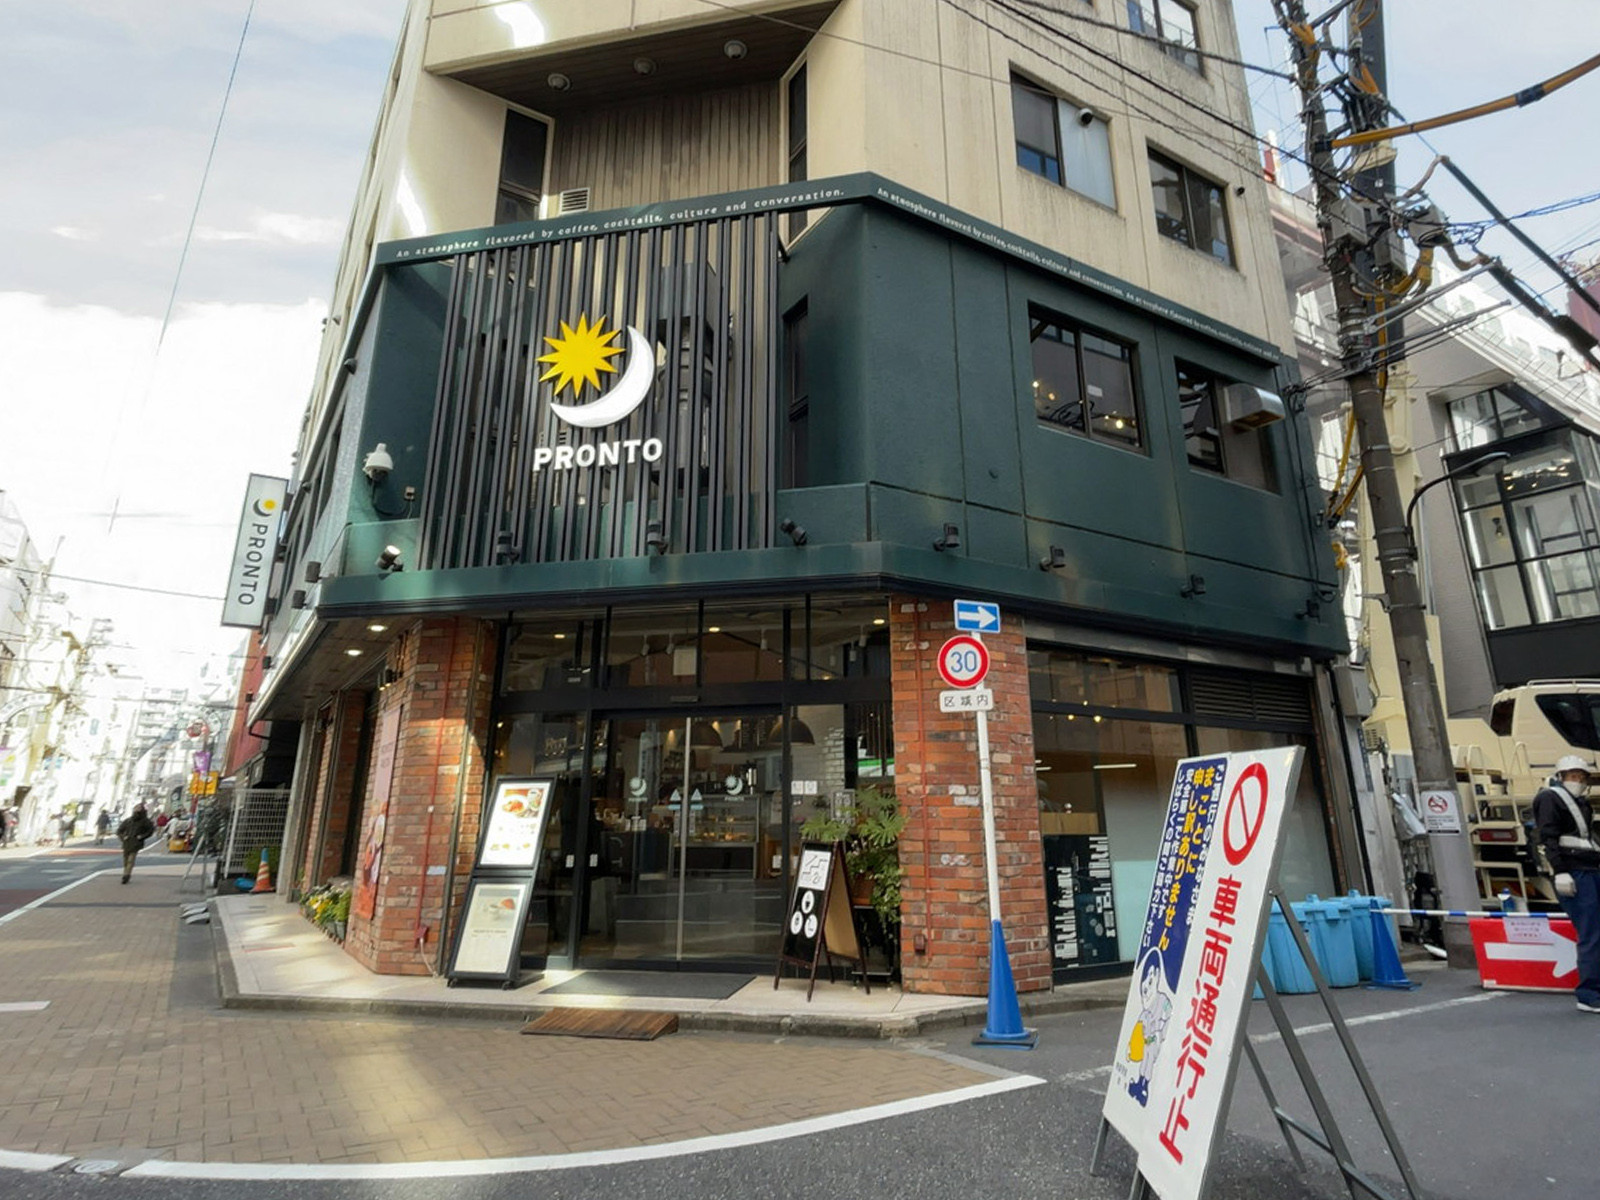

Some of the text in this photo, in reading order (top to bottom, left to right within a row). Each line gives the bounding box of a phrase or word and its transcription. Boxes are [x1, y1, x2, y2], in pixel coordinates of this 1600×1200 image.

[396, 188, 845, 258] An atmosphere flavored by coffee, cocktails, culture and conversation.
[877, 187, 889, 199] An
[890, 194, 937, 219] atmosphere
[938, 213, 972, 233] flavored
[972, 227, 982, 238] by
[1041, 257, 1067, 273] culture
[1069, 269, 1080, 279] and
[532, 437, 663, 471] PRONTO
[238, 522, 268, 605] PRONTO
[944, 695, 989, 707] 区域内
[950, 650, 978, 673] 30
[1158, 767, 1204, 951] 申し訳ありません
[1185, 766, 1216, 874] まことに
[1158, 873, 1242, 1165] 車両通行止
